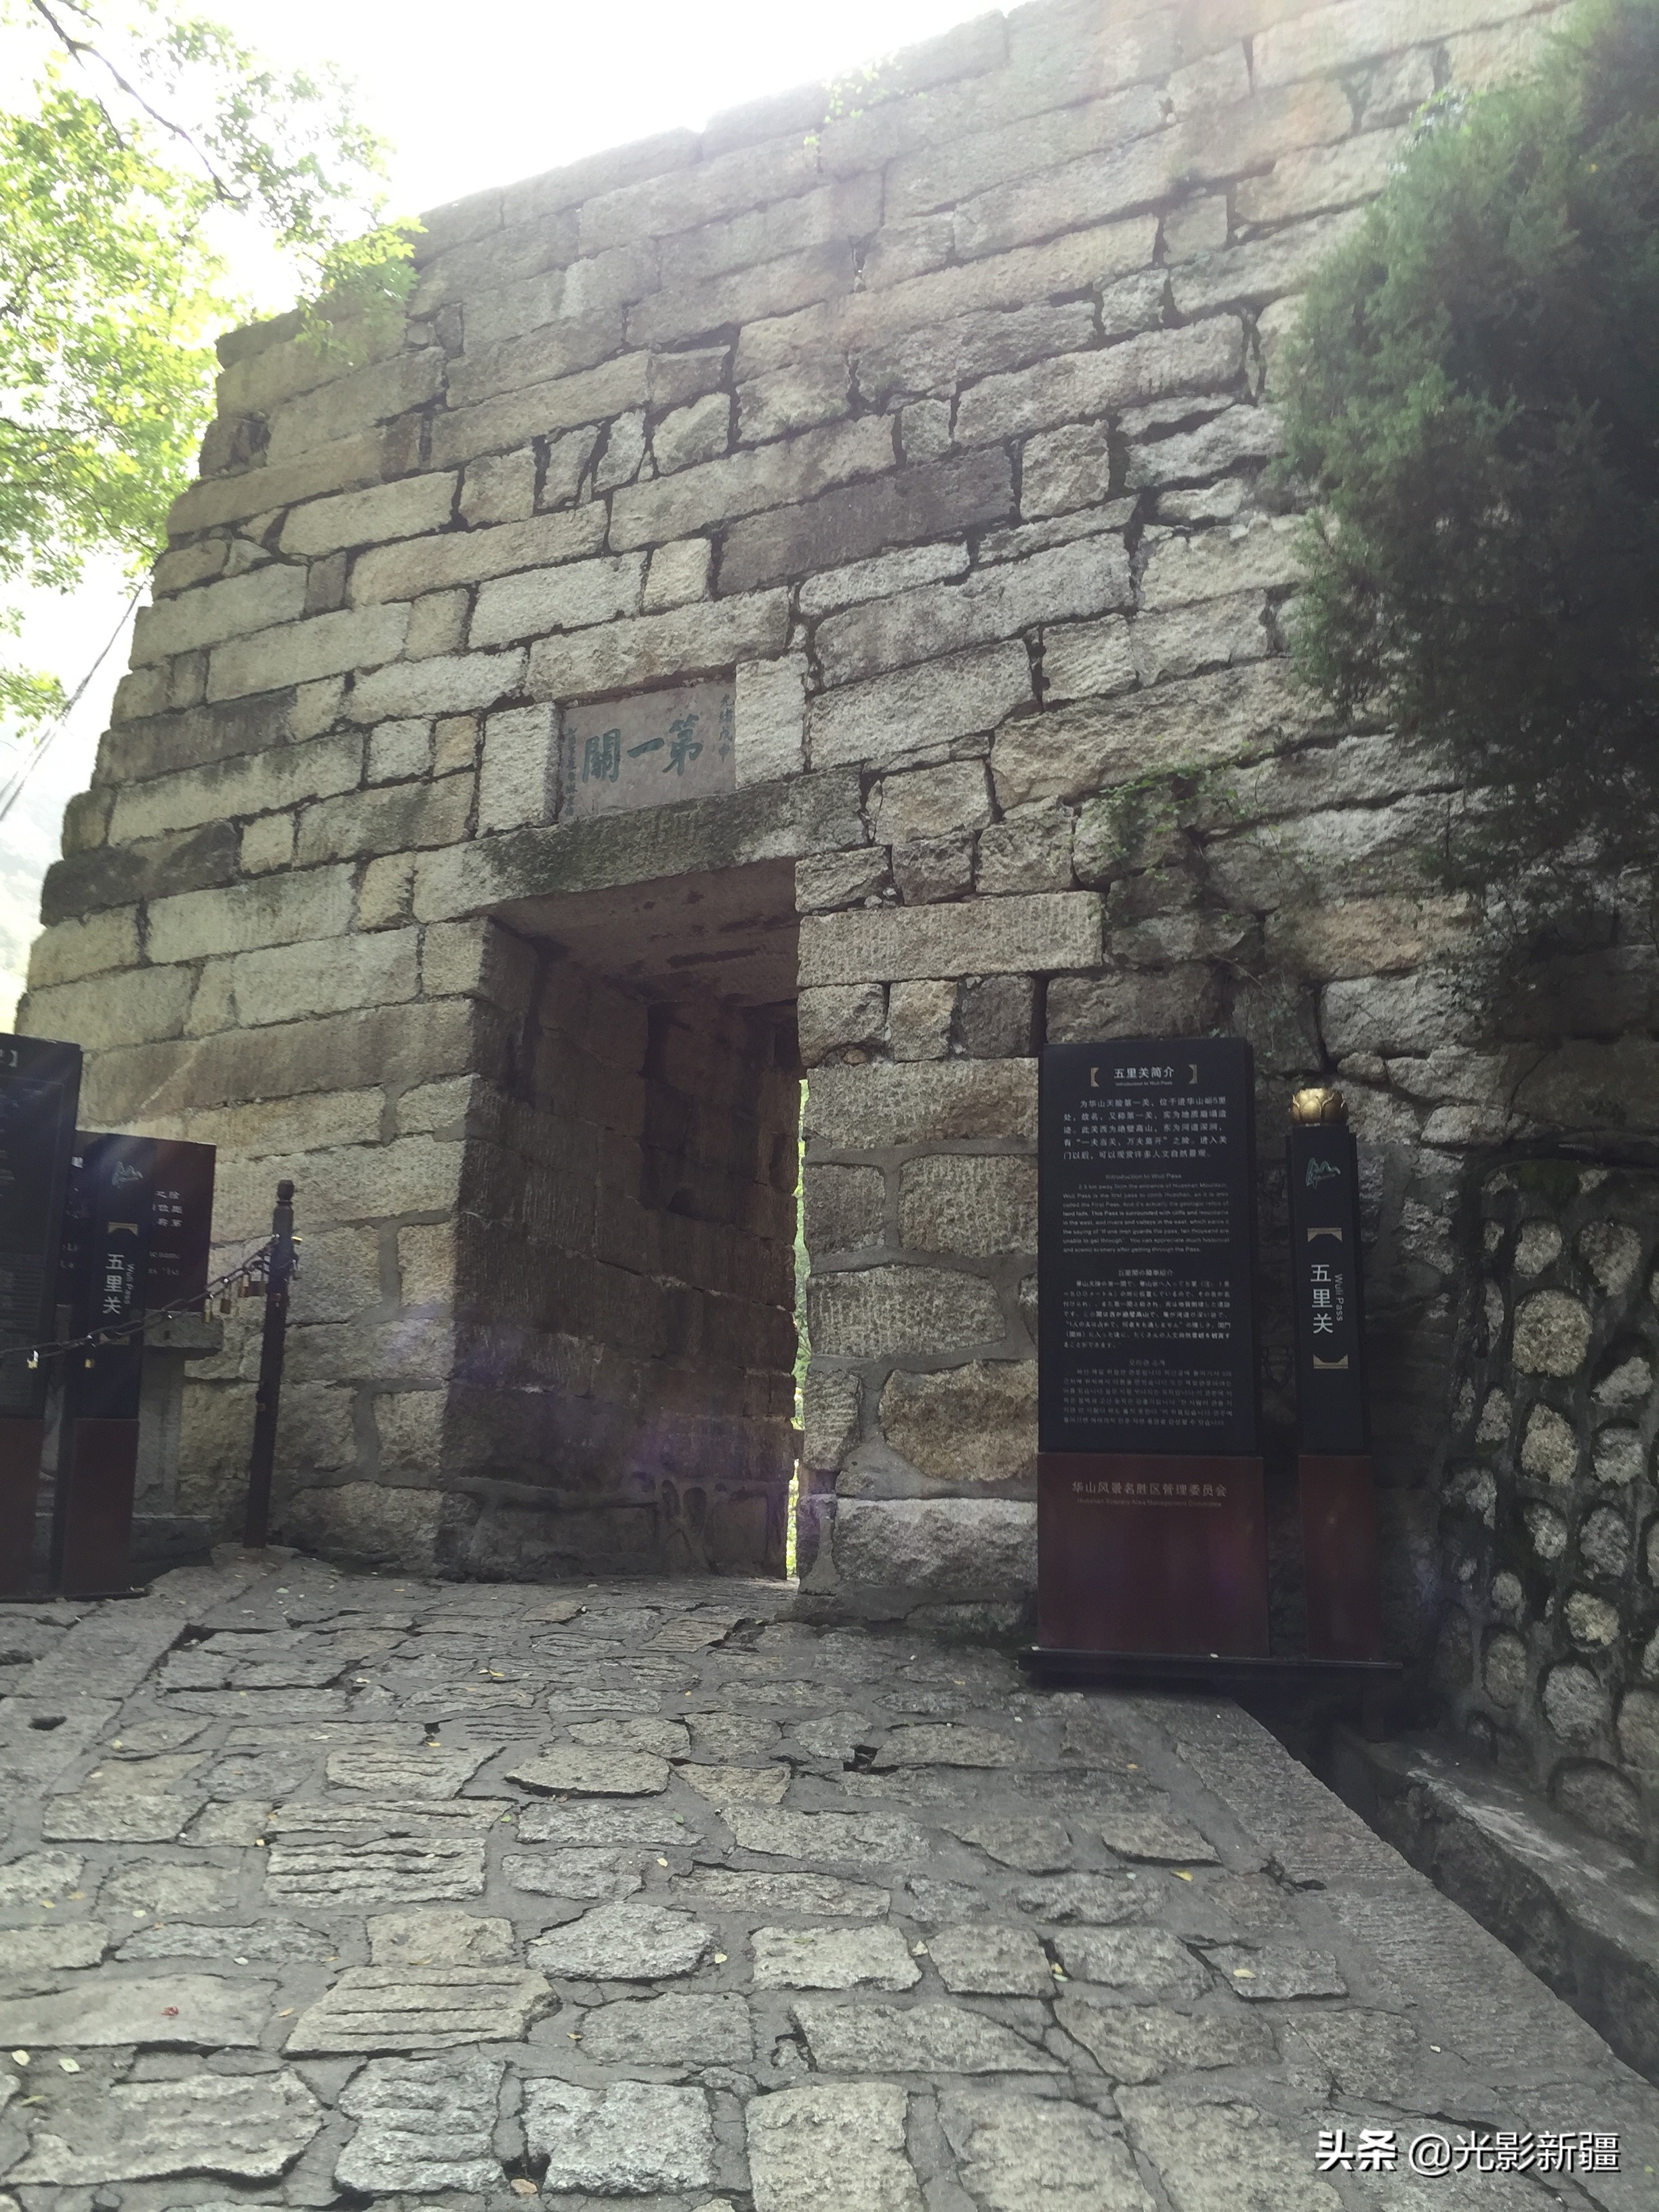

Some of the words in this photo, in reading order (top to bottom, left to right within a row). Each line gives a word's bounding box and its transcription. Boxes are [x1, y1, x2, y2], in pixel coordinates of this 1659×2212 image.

[1113, 1066, 1174, 1080] 五里关简介
[102, 1253, 125, 1315] 五里关
[1334, 1273, 1343, 1294] Wuli
[1310, 1263, 1334, 1334] 五里关
[1336, 1297, 1345, 1322] Pass
[1071, 1481, 1227, 1498] 华山风景名胜区管理委员会
